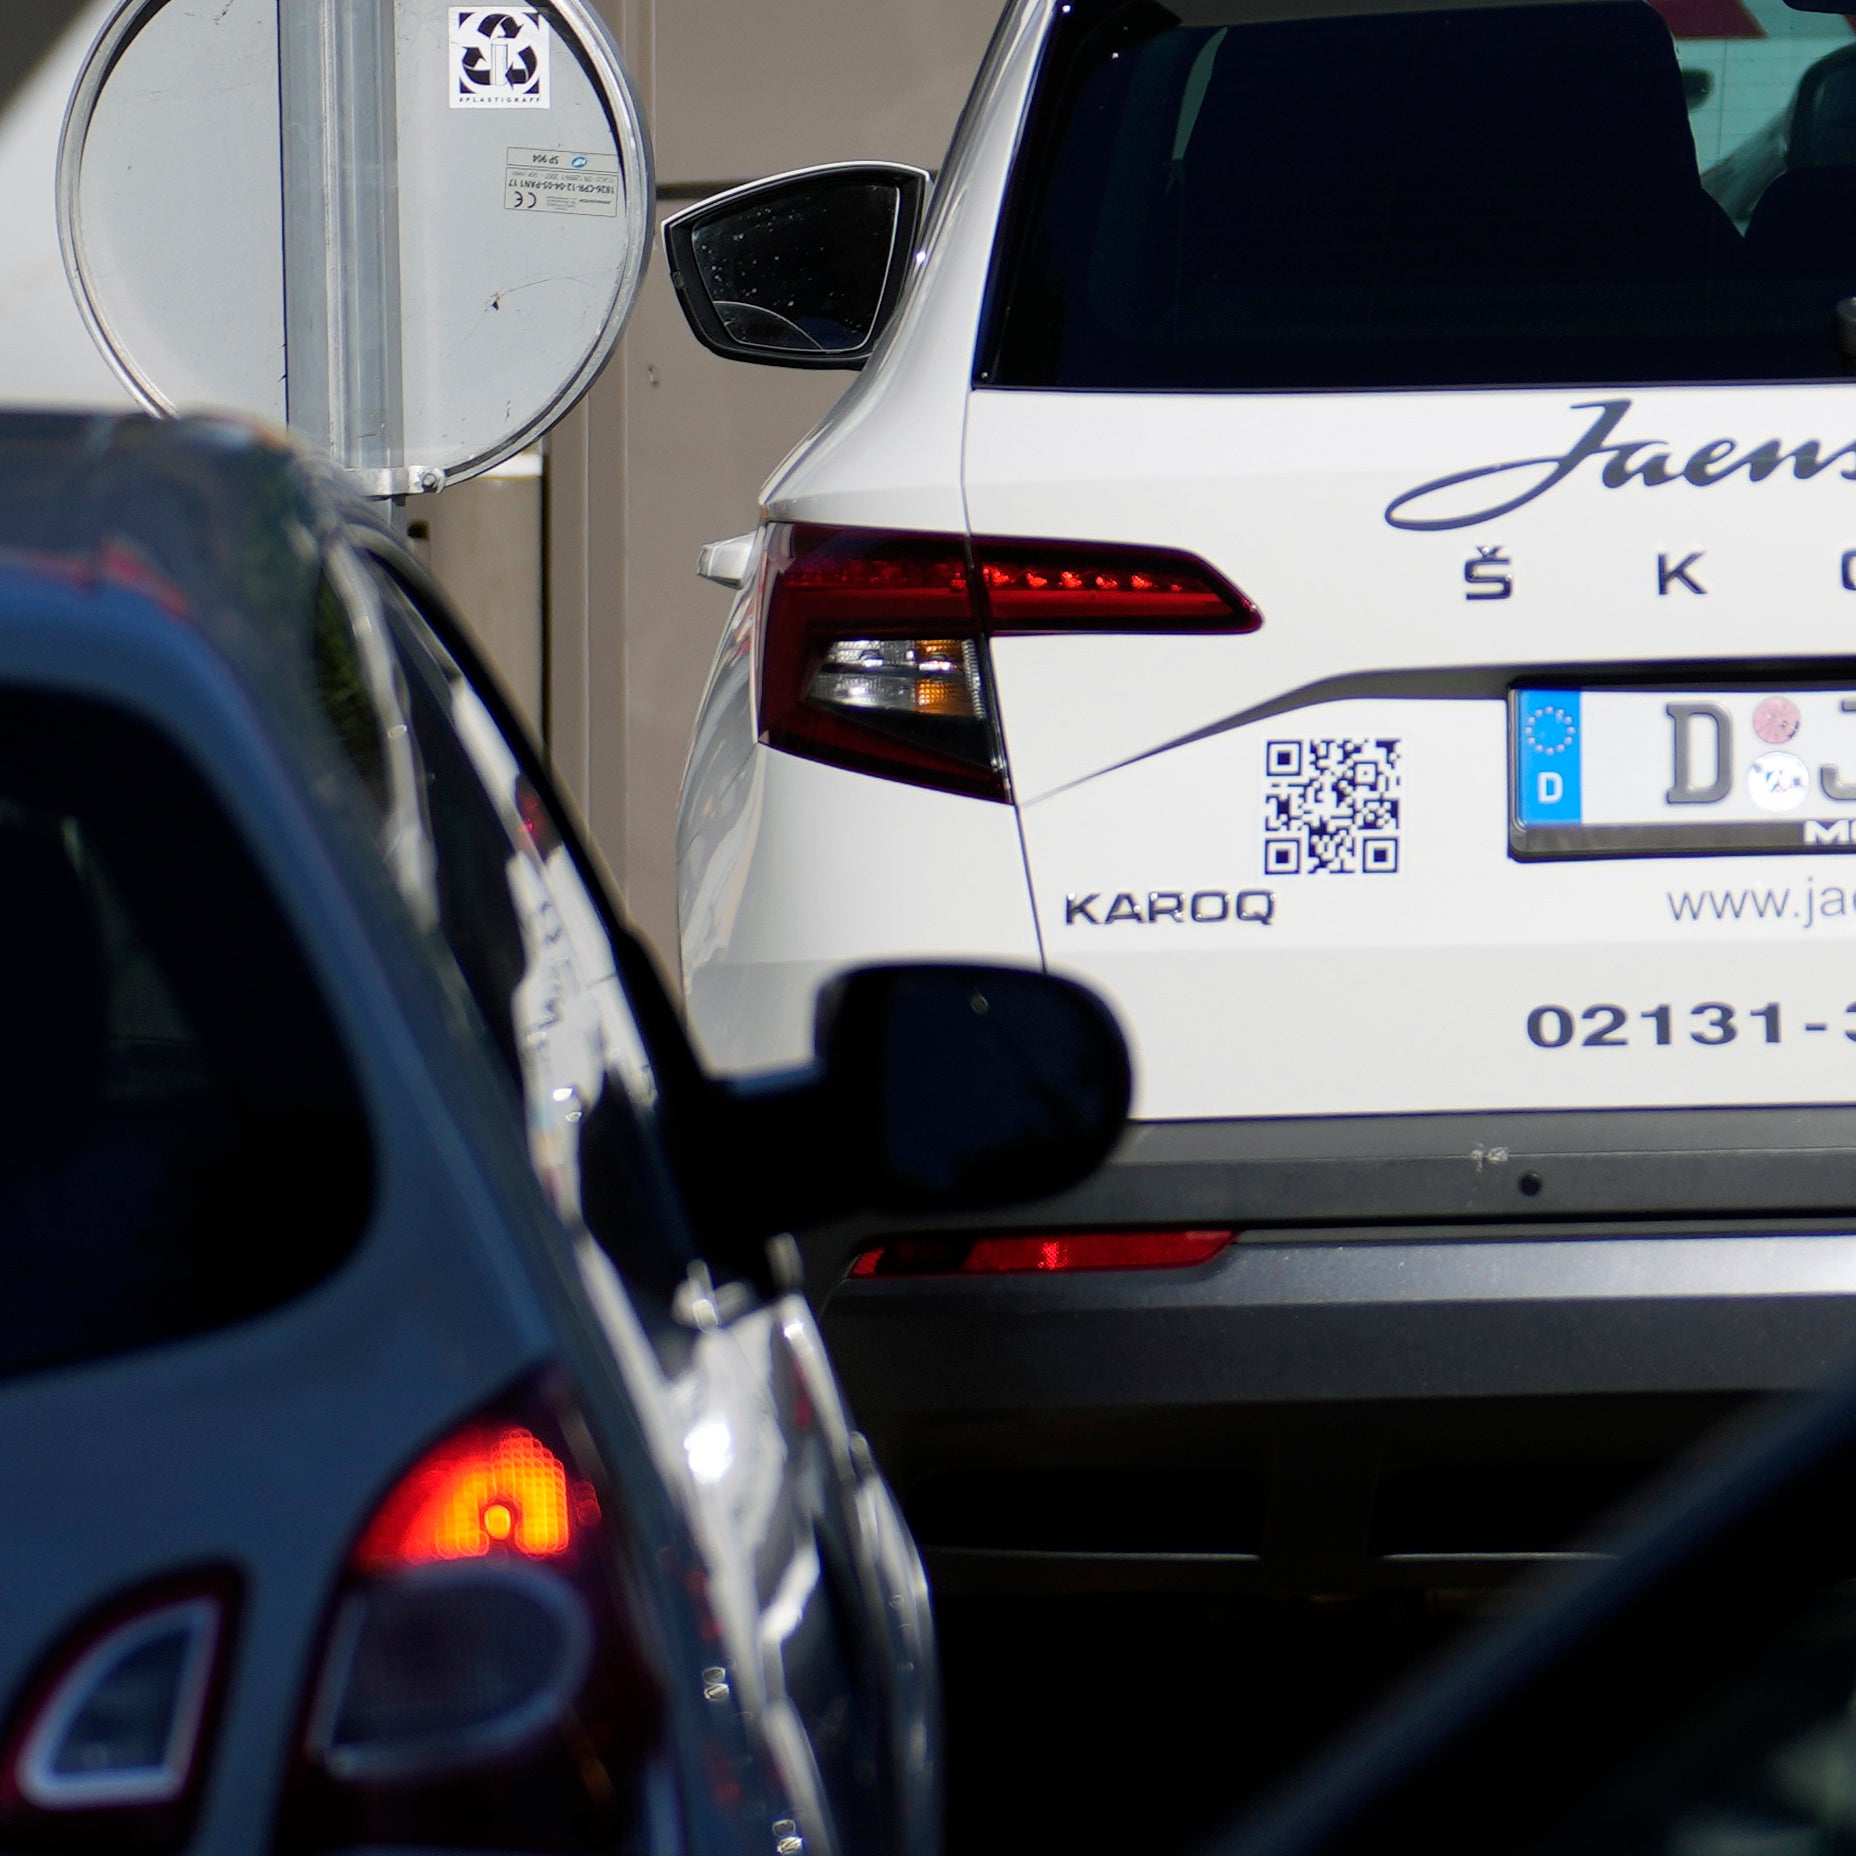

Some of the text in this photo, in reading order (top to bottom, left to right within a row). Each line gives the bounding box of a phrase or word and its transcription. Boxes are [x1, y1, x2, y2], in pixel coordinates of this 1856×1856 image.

[1664, 700, 1735, 805] D
[1536, 773, 1563, 804] D
[1065, 889, 1278, 926] KAROQ
